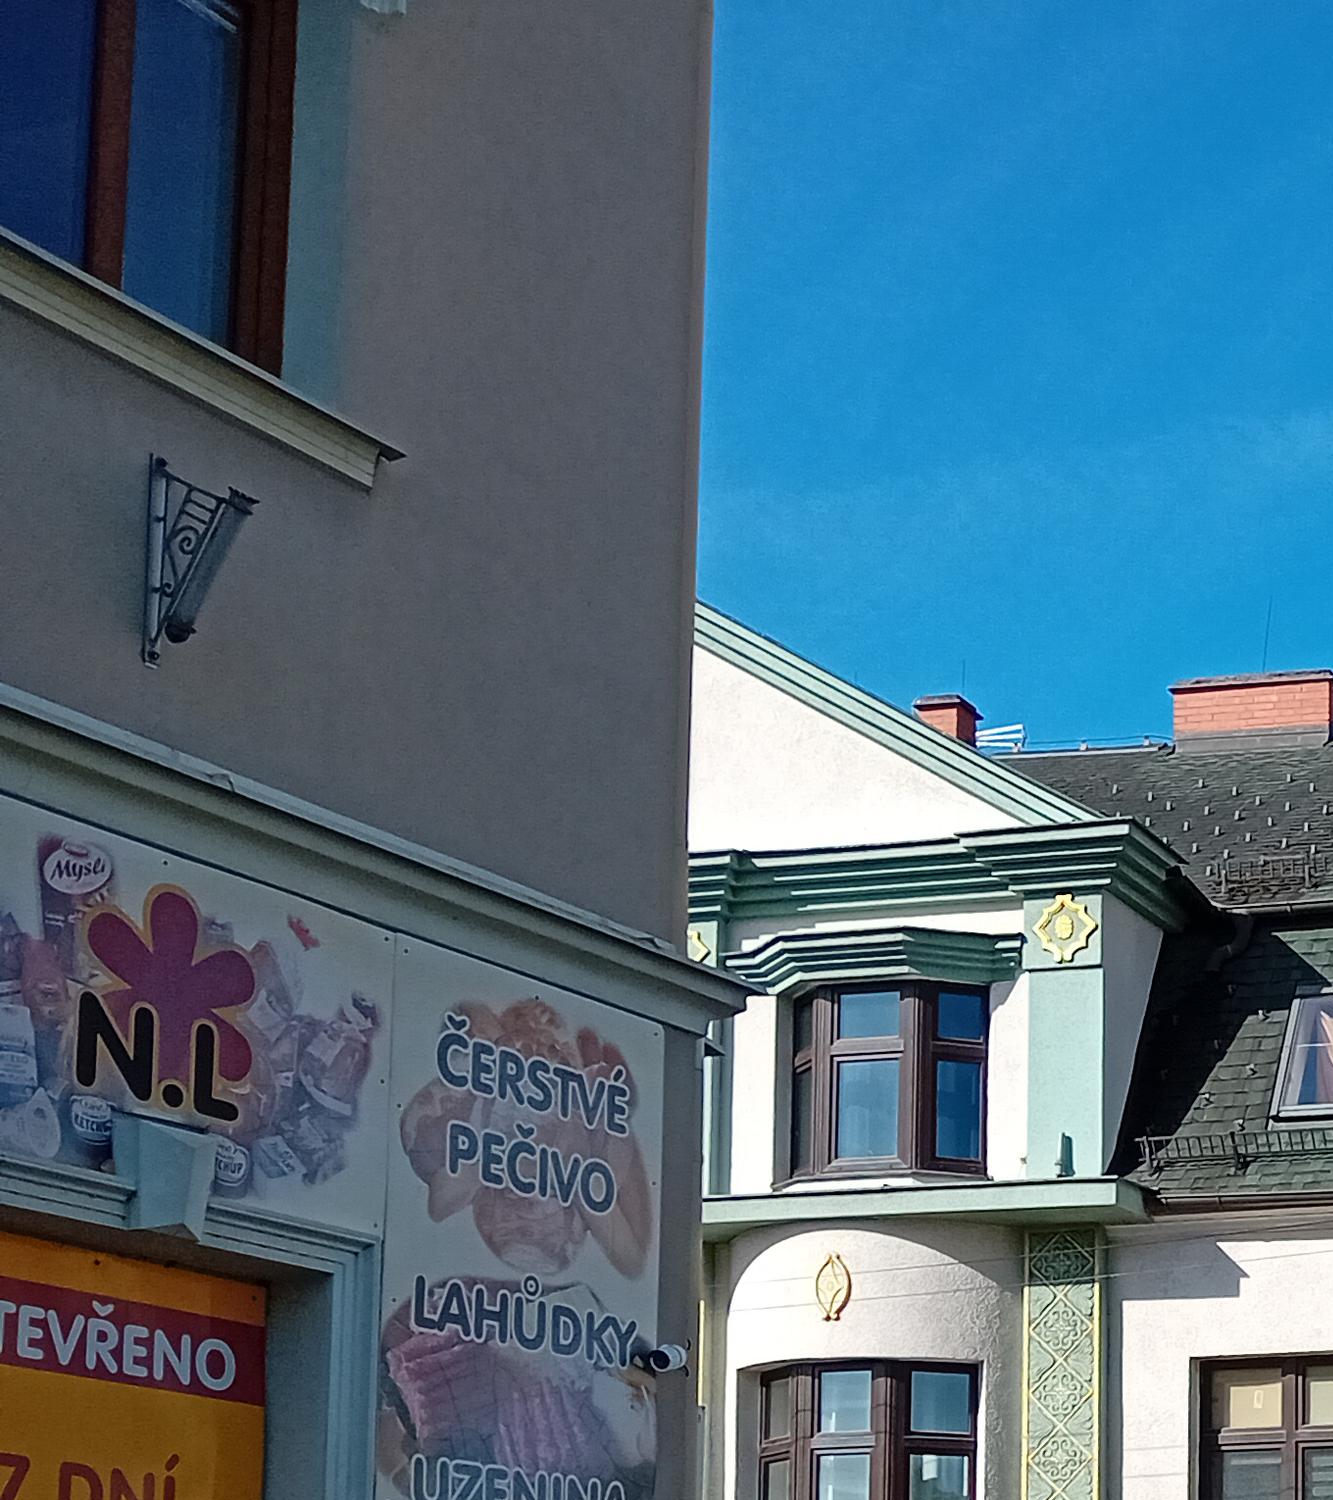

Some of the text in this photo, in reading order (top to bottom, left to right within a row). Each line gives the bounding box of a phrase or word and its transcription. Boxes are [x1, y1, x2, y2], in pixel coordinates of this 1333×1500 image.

[434, 1011, 630, 1137] ČERSTVÉ
[446, 1123, 617, 1217] PEČIVO
[412, 1273, 638, 1369] LAHŮDKY
